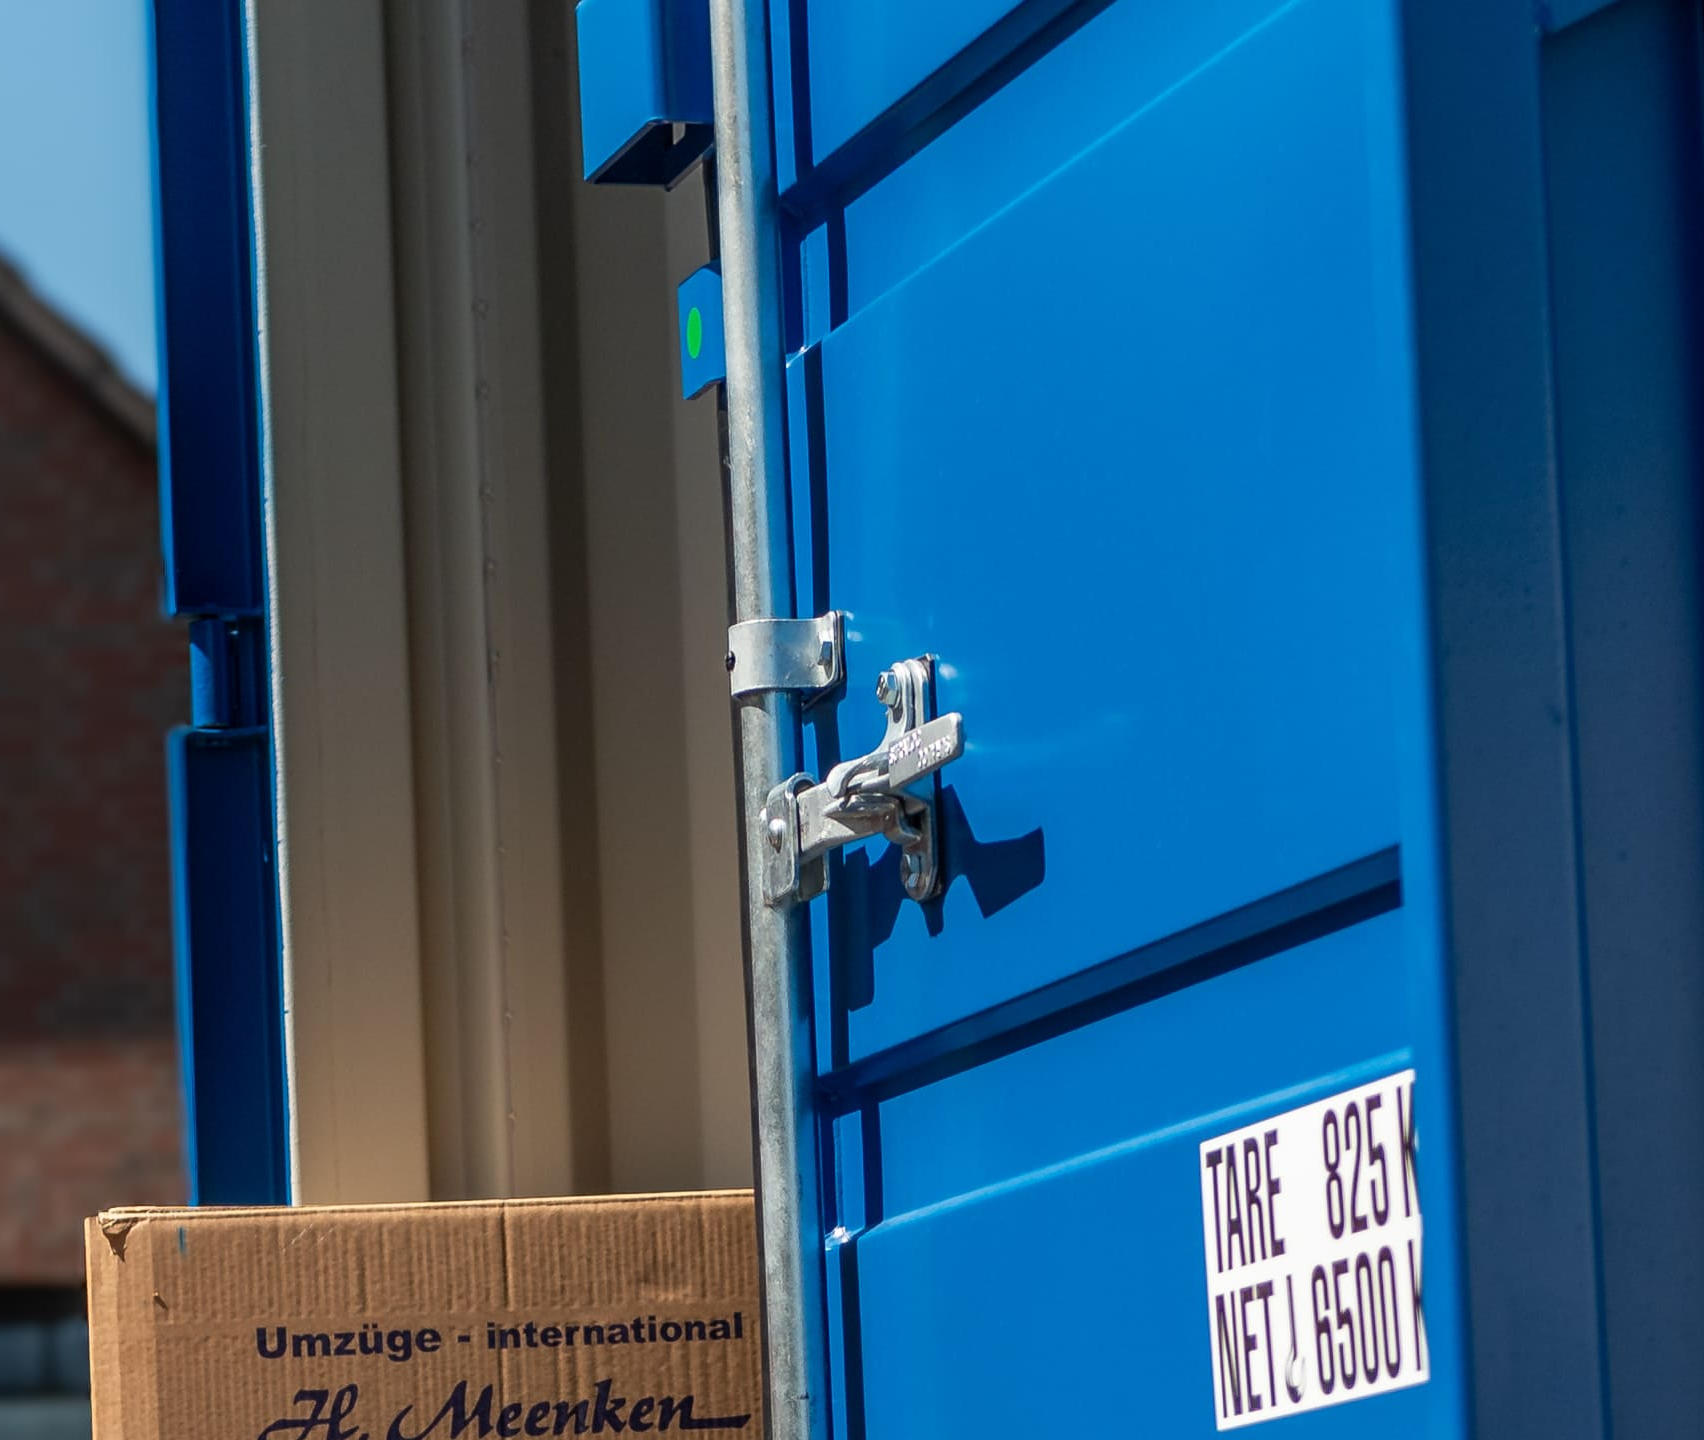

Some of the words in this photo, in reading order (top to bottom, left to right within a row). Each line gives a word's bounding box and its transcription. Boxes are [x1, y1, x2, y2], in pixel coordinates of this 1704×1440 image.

[1206, 1129, 1286, 1273] TARE
[1322, 1093, 1389, 1240] 825
[255, 1325, 442, 1362] Umzüge
[487, 1312, 744, 1350] international
[1311, 1245, 1401, 1395] 6500
